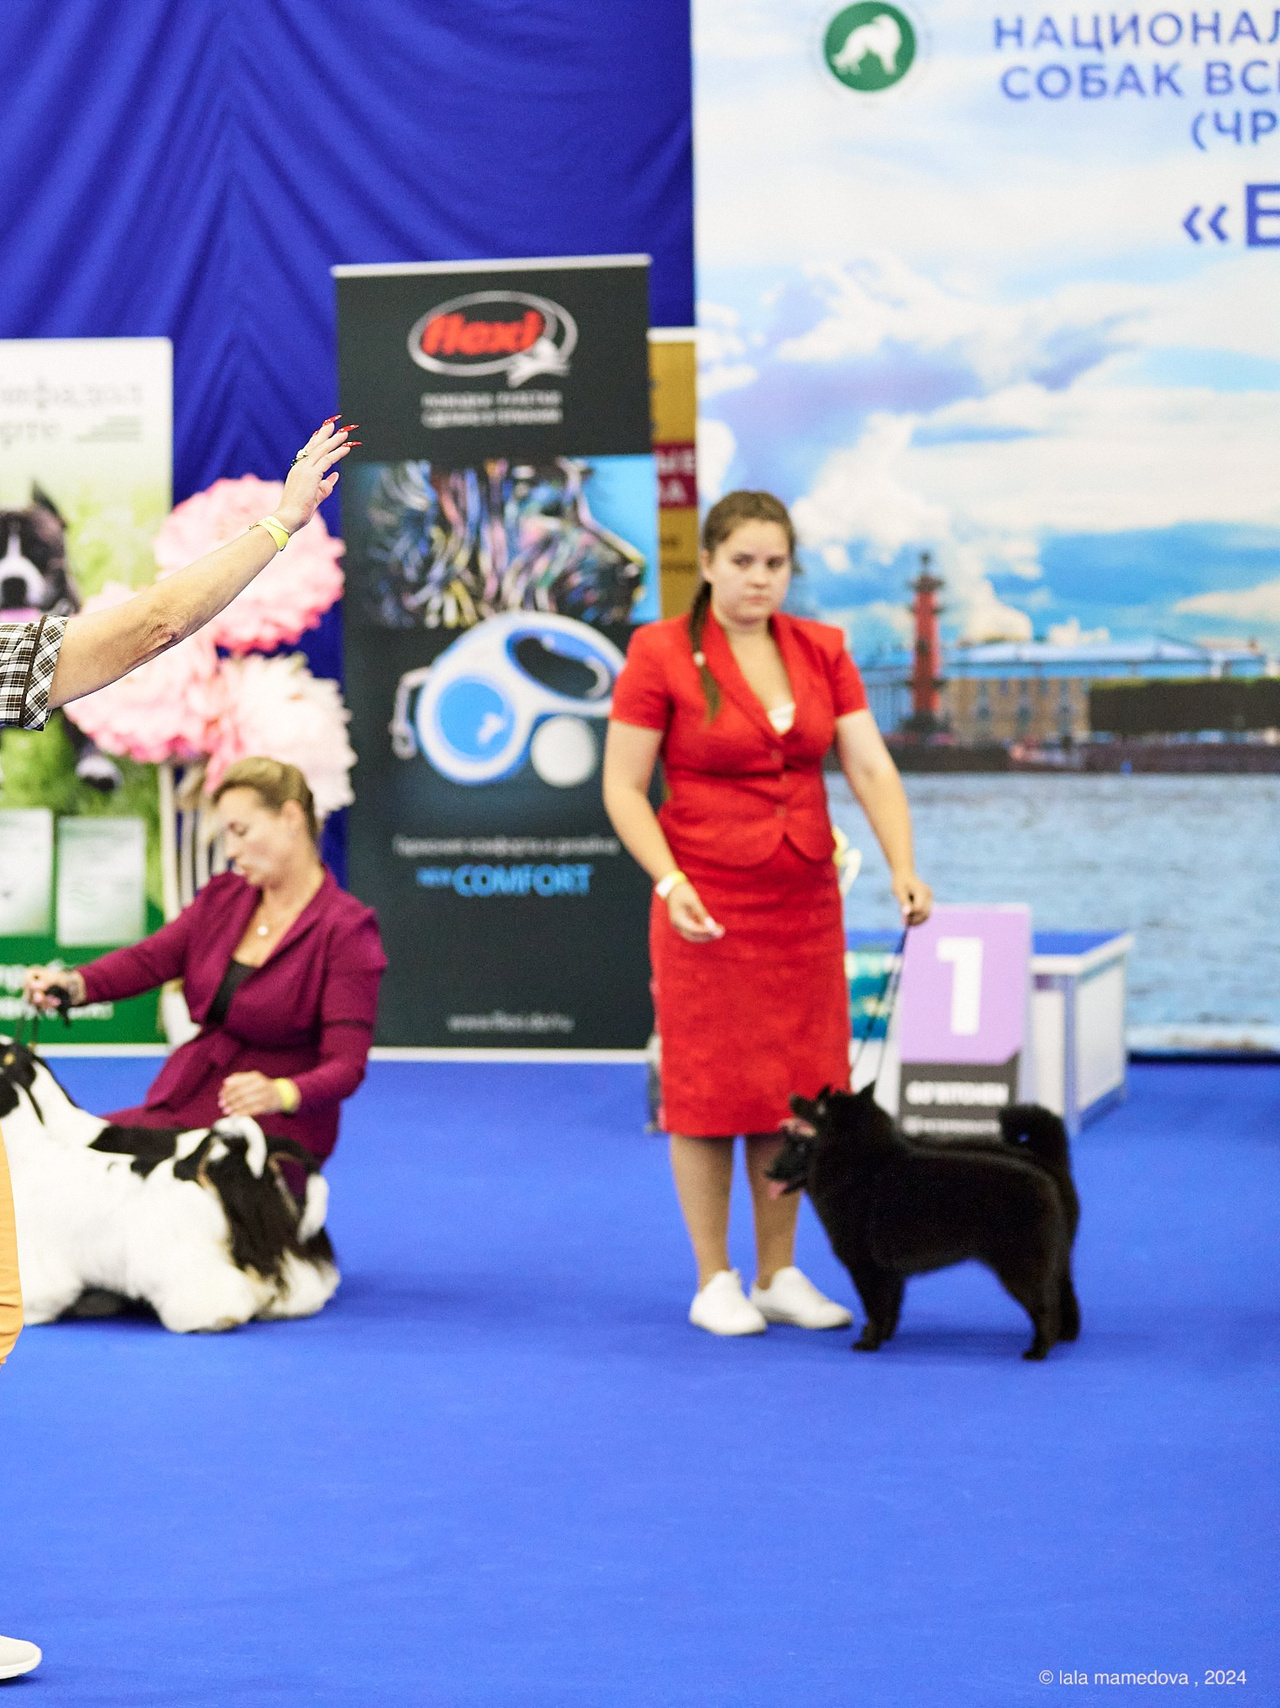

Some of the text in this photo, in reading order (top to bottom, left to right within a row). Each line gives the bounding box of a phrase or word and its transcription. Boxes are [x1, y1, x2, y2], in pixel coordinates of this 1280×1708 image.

[1000, 59, 1280, 101] СОБАК ВС
[936, 936, 984, 1036] 1
